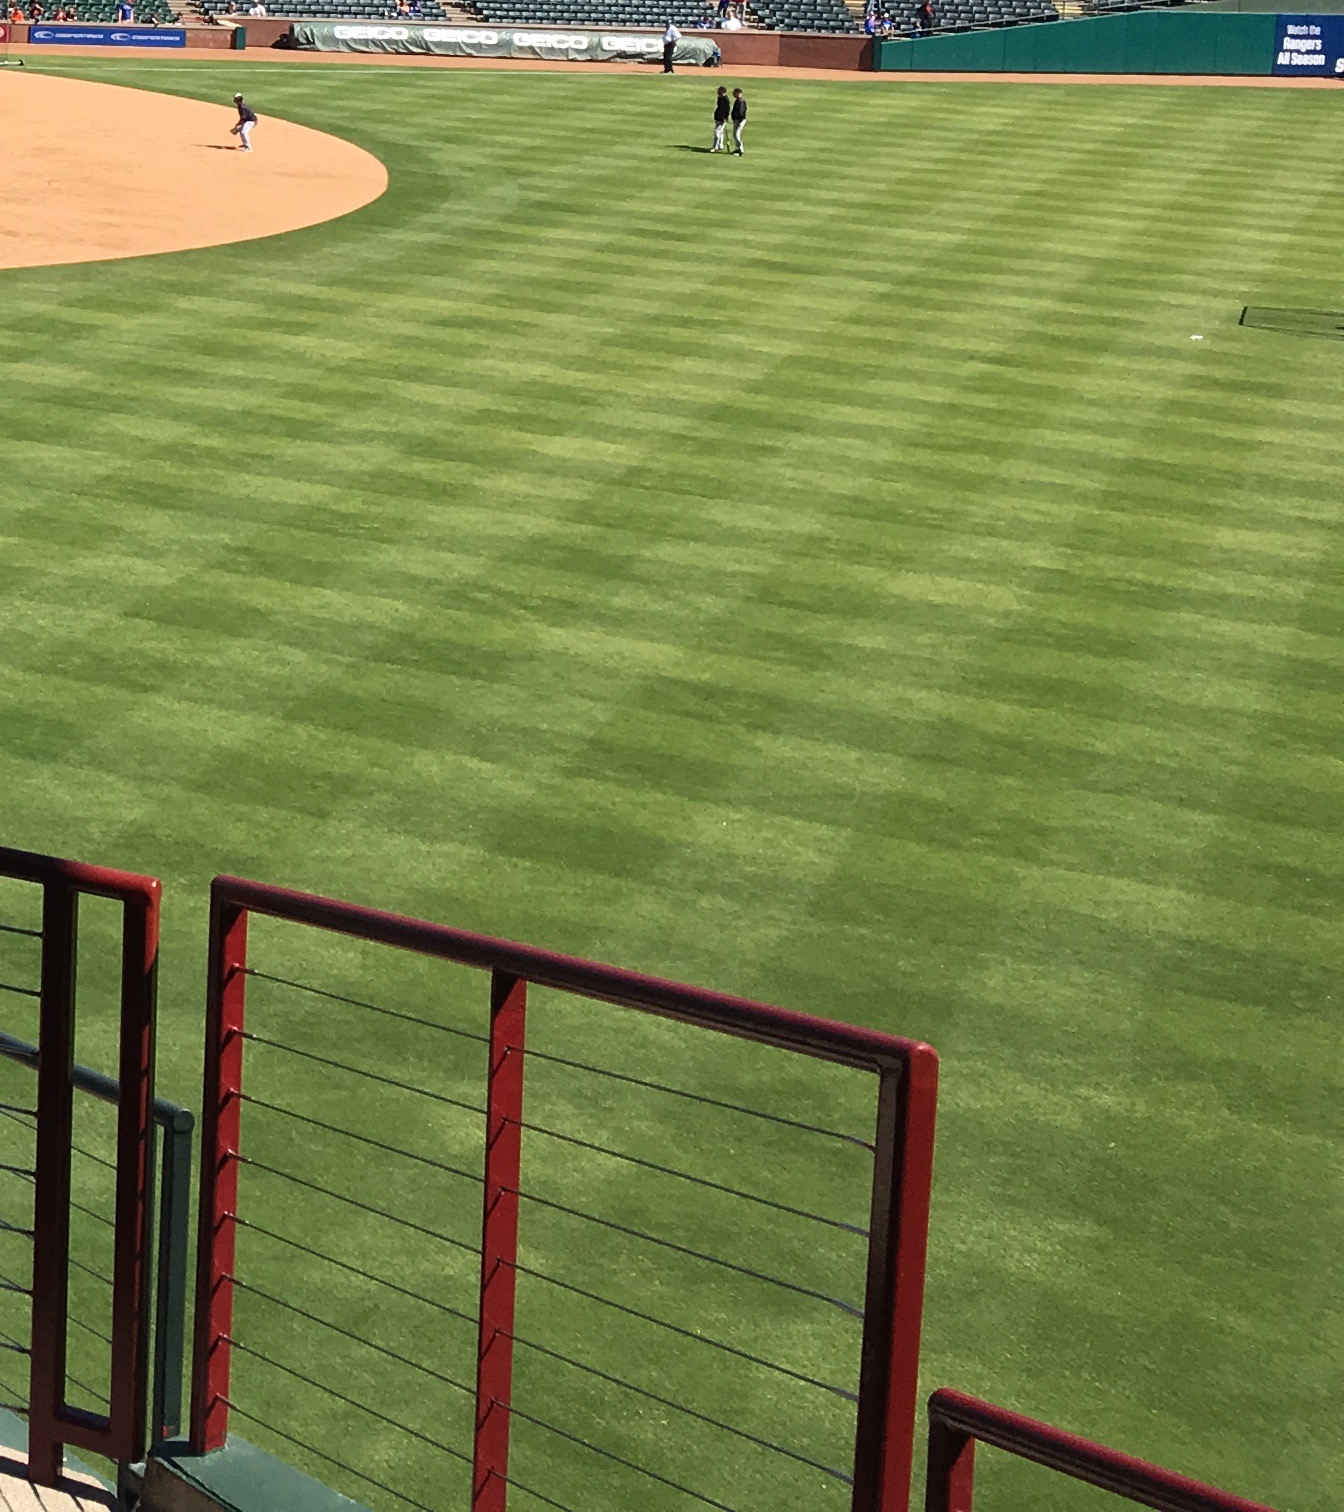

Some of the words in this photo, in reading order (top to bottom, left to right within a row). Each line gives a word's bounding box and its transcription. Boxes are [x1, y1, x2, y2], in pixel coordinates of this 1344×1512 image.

[333, 25, 409, 40] GEICO
[423, 27, 499, 45] GEICO
[512, 30, 589, 50] GEICO
[1282, 36, 1323, 53] Rangers
[1276, 51, 1291, 65] All
[1290, 52, 1326, 66] Season
